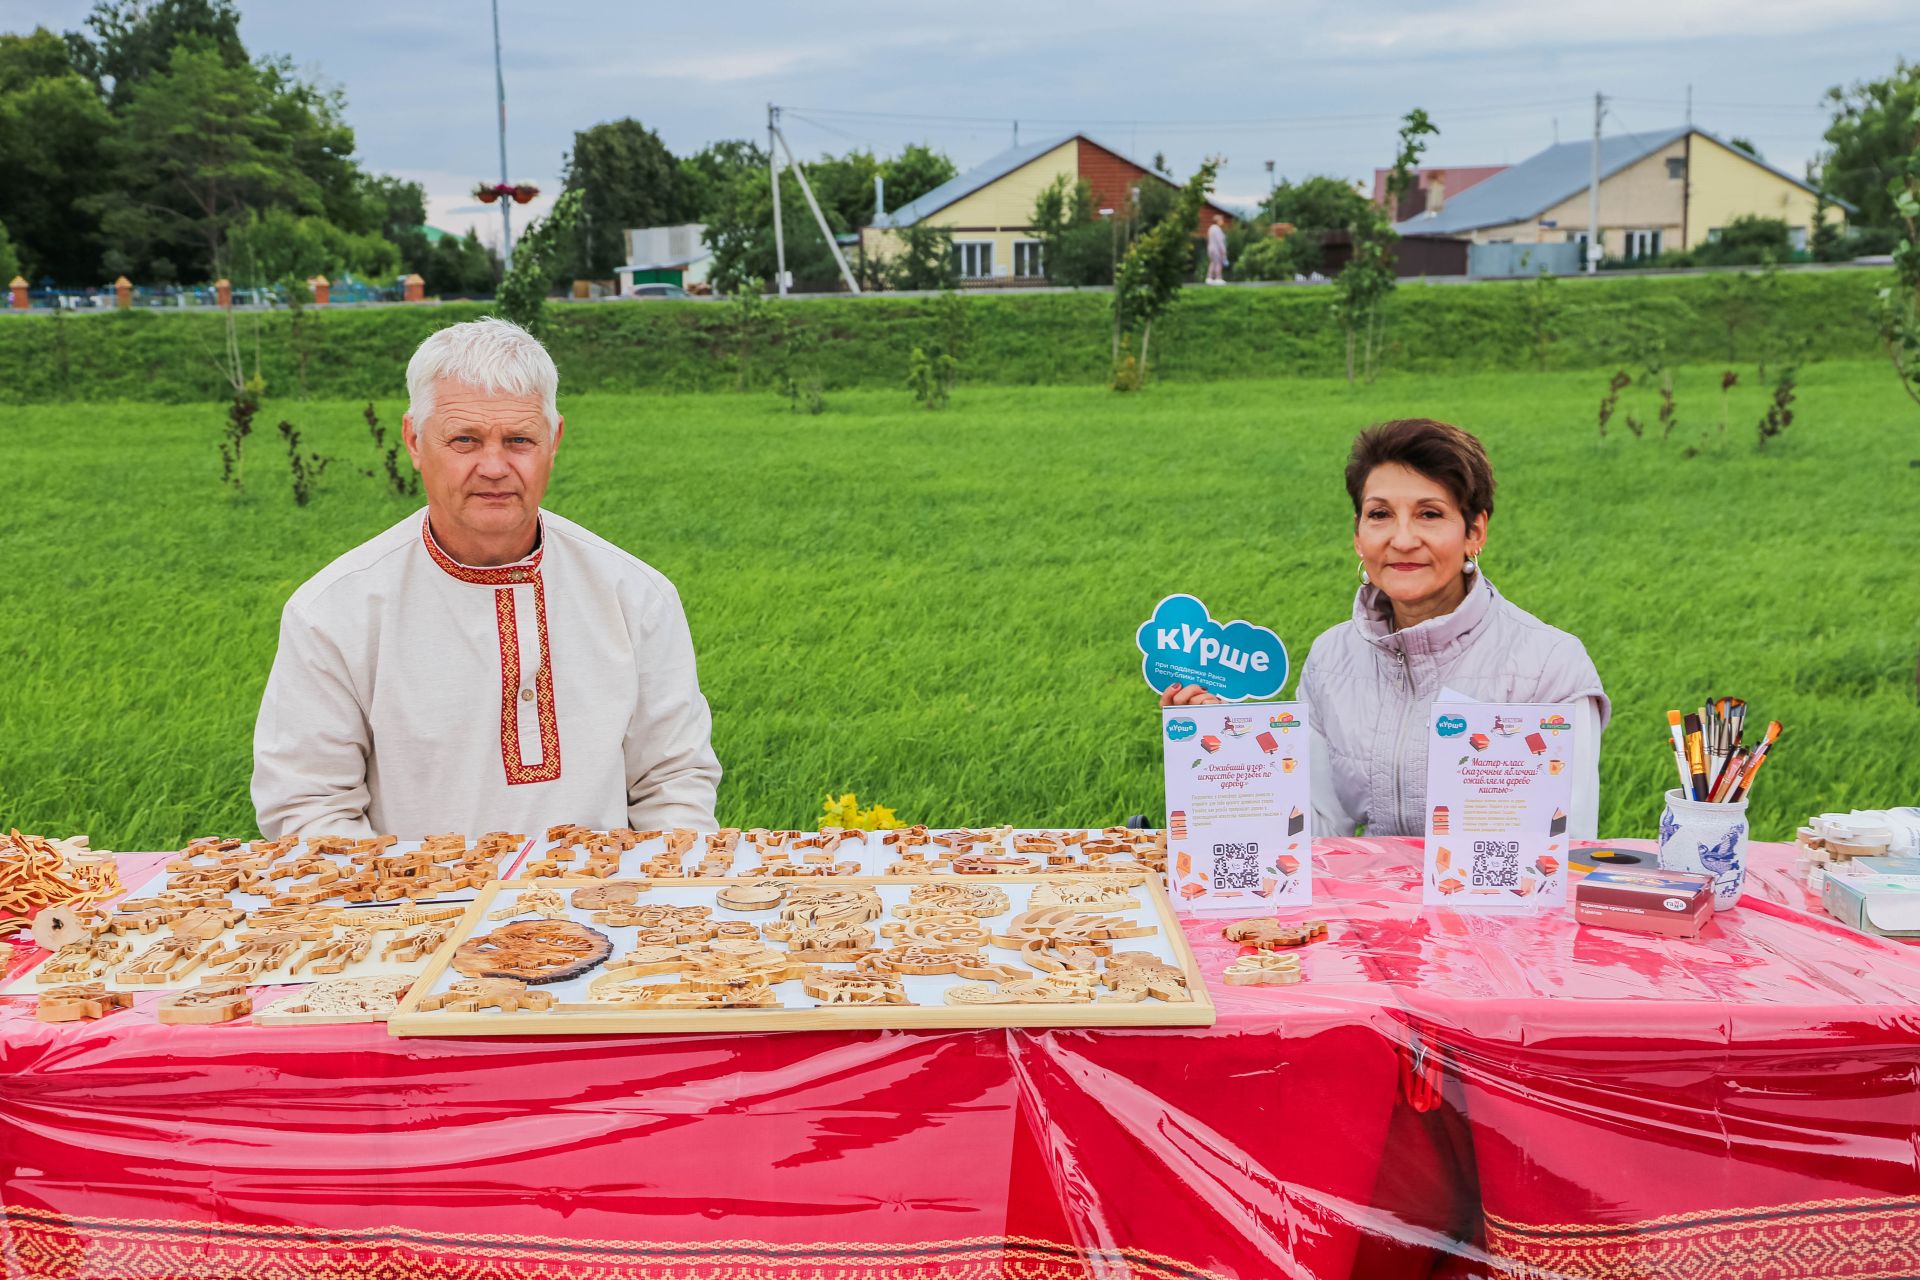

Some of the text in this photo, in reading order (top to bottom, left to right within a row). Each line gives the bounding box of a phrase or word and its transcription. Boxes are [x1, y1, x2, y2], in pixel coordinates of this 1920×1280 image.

[1154, 667, 1227, 689] Республики Татарстан
[1169, 664, 1207, 677] поддержке
[1207, 672, 1226, 682] Раиса
[1472, 758, 1525, 768] Мастер-класс
[1197, 771, 1235, 782] искусство
[1463, 776, 1531, 786] оживляем дерево
